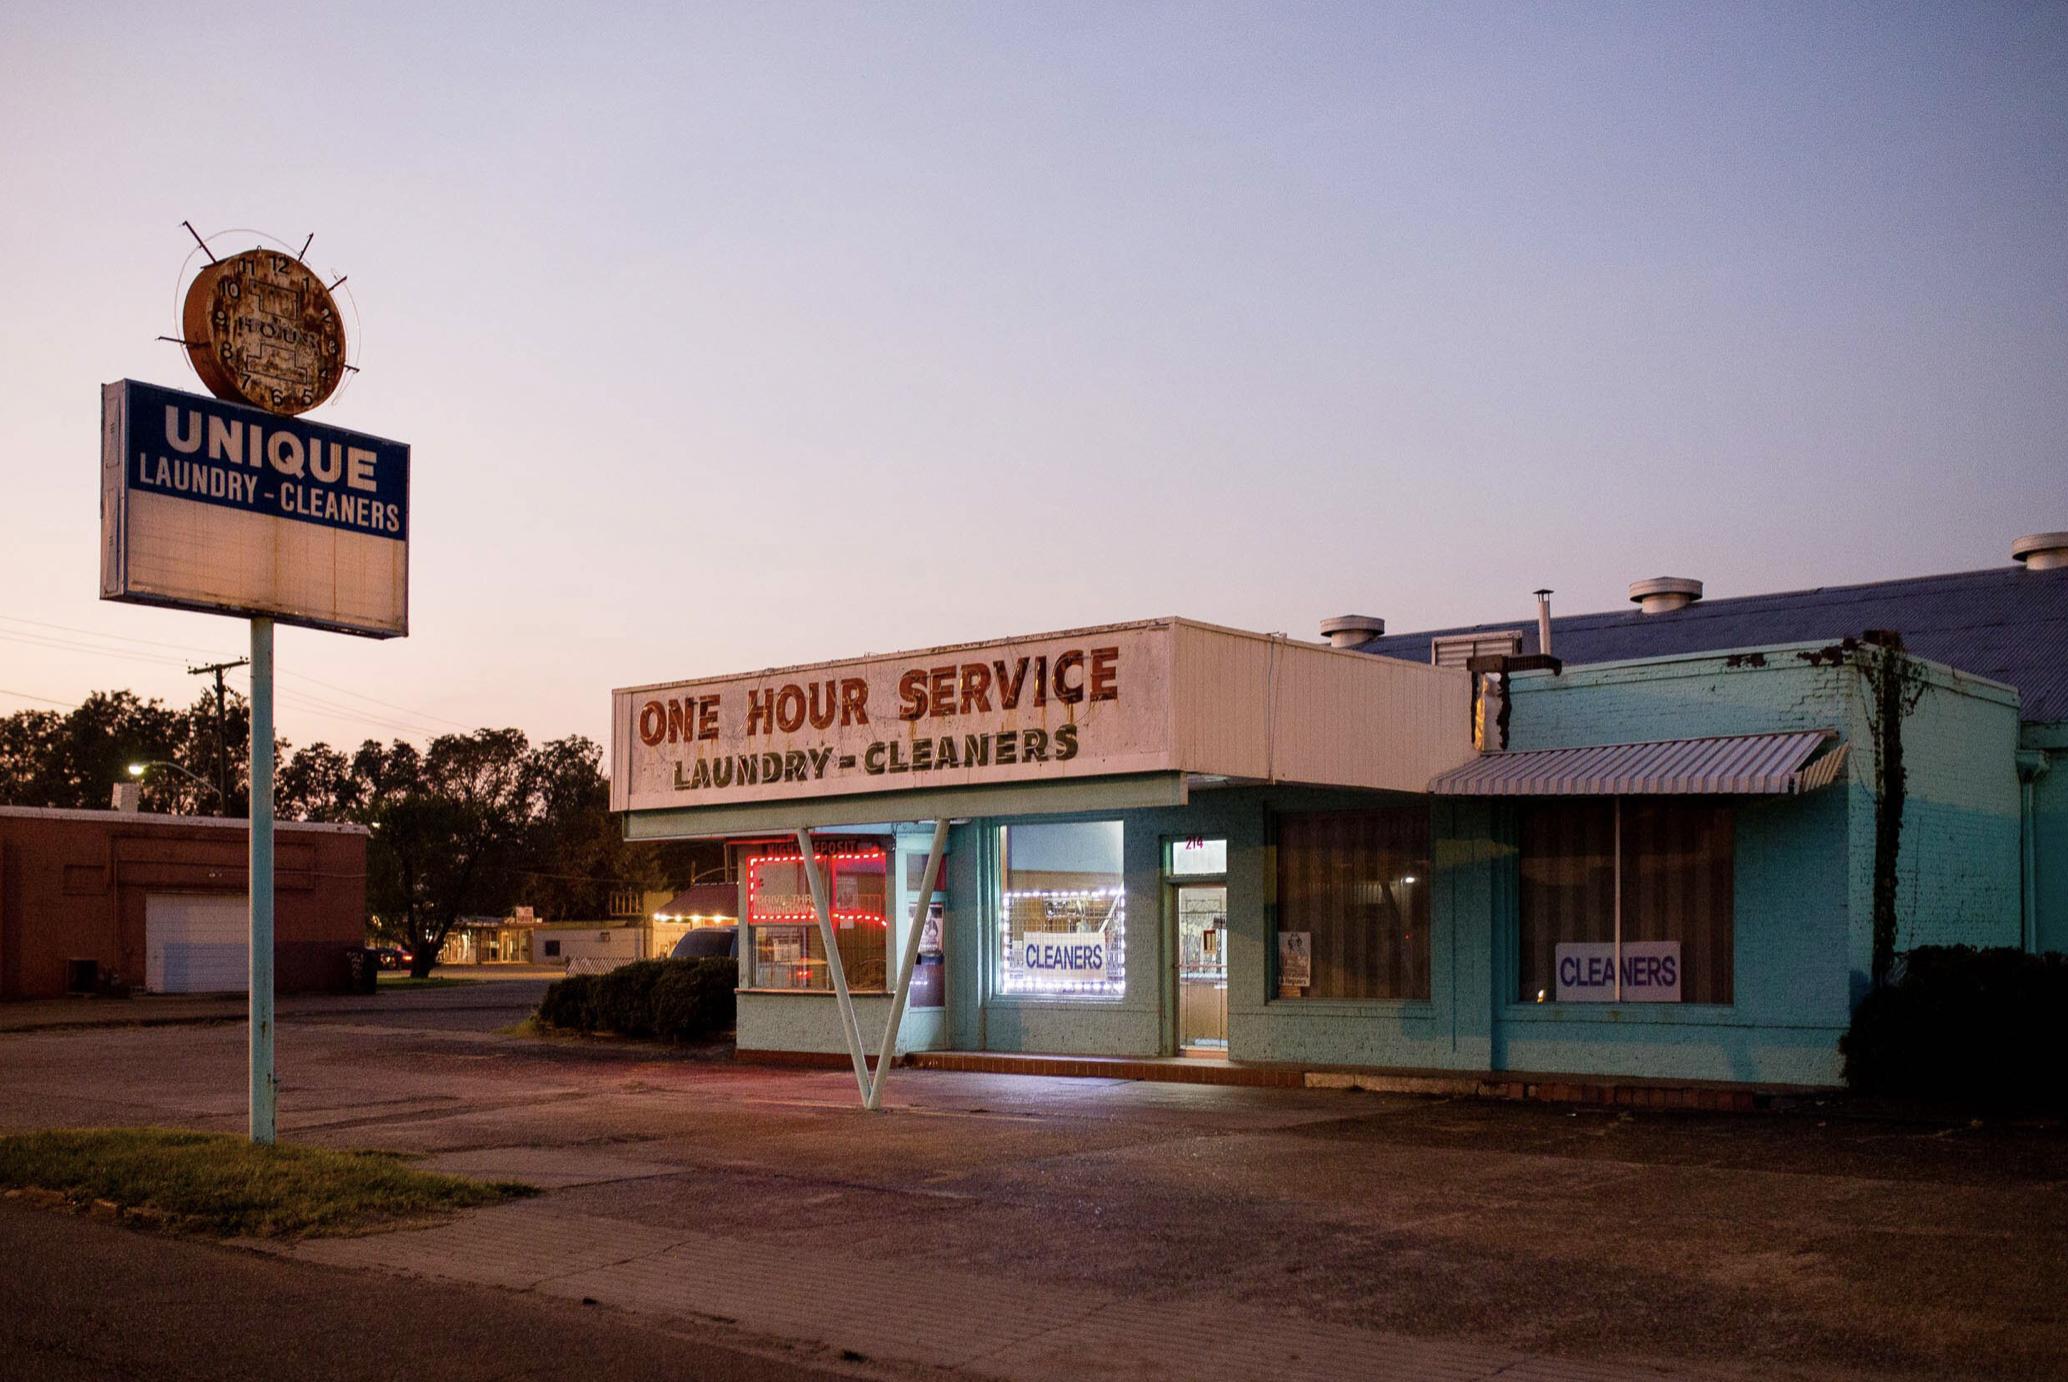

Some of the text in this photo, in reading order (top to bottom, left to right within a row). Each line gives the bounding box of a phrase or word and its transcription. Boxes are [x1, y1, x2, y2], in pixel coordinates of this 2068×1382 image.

[239, 257, 255, 276] 11
[270, 255, 289, 274] 12
[218, 278, 240, 299] 10
[303, 277, 310, 292] 1
[215, 310, 227, 327] 9
[321, 307, 332, 324] 2
[238, 316, 320, 356] HOUR
[221, 340, 233, 360] 8
[327, 340, 337, 354] 3
[240, 372, 251, 390] 7
[319, 369, 330, 383] 4
[271, 388, 284, 406] 6
[301, 388, 313, 406] 5
[165, 405, 377, 492] UNIQUE
[140, 452, 258, 503] LAUNDRY
[280, 482, 400, 532] CLEANERS
[639, 646, 1119, 748] ONE HOUR SERVICE
[674, 747, 833, 791] LAUNDRY
[864, 723, 1079, 775] CLEANERS
[815, 840, 856, 855] EPOSIT
[1185, 836, 1203, 850] 214
[791, 894, 812, 904] THR
[766, 904, 809, 915] WINDOW
[1026, 944, 1102, 970] CLEANERS
[1560, 956, 1676, 987] CLEANERS
